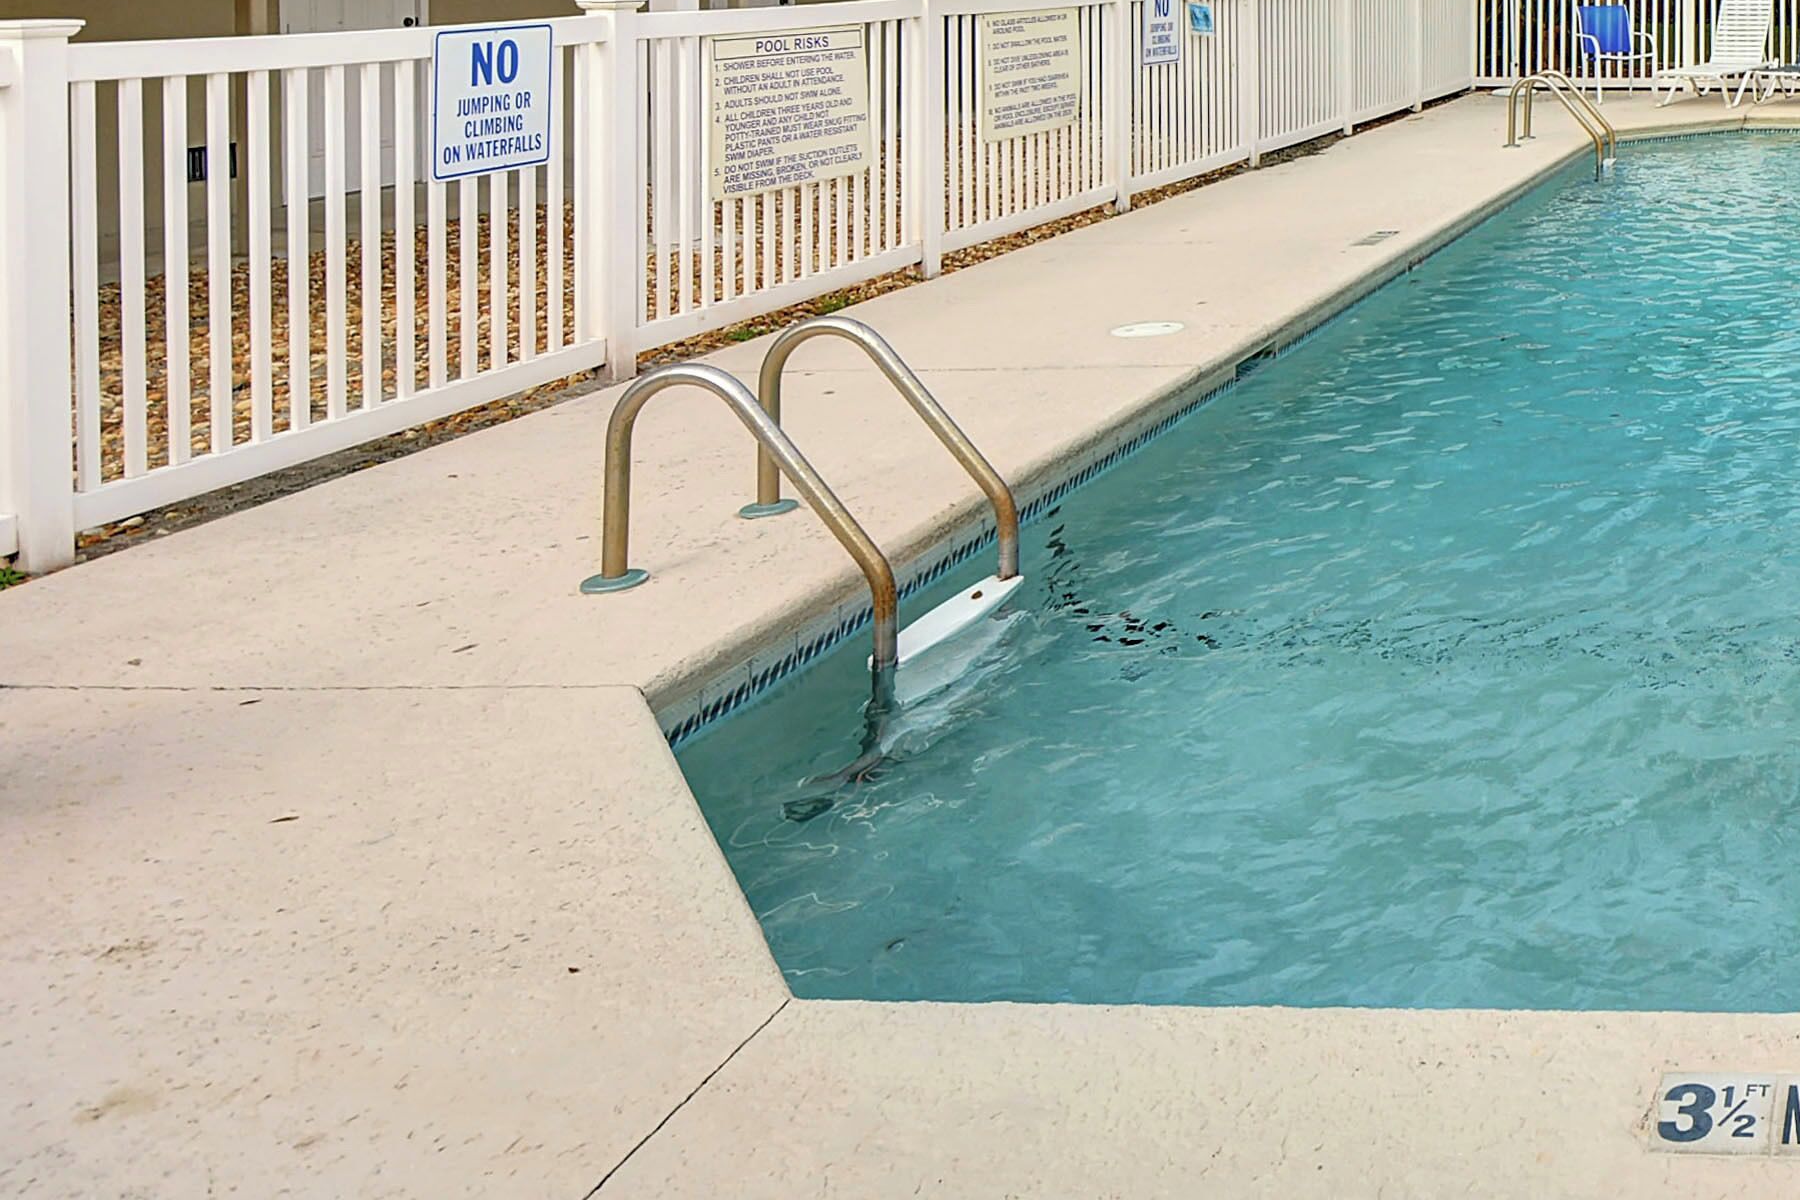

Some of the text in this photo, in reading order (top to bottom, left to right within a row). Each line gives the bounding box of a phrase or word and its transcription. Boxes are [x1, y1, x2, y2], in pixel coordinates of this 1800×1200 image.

[756, 36, 829, 53] POOL RISKS
[472, 39, 518, 86] NO
[723, 60, 755, 71] SHOWER
[757, 57, 784, 68] BEFORE
[786, 54, 820, 65] ENTERING
[821, 53, 833, 61] THE
[723, 74, 760, 86] CHILDREN
[761, 72, 784, 82] SHALL
[785, 70, 800, 79] NOT
[801, 68, 814, 77] USE
[815, 66, 834, 75] POOL
[723, 83, 757, 95] WITHOUT
[758, 81, 768, 90] AN
[769, 79, 791, 89] ADULT
[792, 78, 800, 87] IN
[457, 91, 531, 117] JUMPING OR
[724, 97, 753, 108] ADULTS
[754, 94, 783, 105] SHOULD
[784, 92, 799, 101] NOT
[800, 90, 818, 99] SWIM
[724, 113, 739, 122] ALL
[740, 109, 776, 120] CHILDREN
[778, 105, 801, 115] THREE
[802, 102, 824, 112] YEARS
[825, 99, 839, 108] OLD
[839, 98, 853, 106] AND
[465, 114, 522, 138] CLIMBING
[725, 109, 829, 132] YOUNGER AND ANY CHILD NOT
[725, 112, 867, 142] POTTY-TRAINED MUST WEAR SNUG FITTING
[443, 133, 541, 164] ON WATERFALLS
[725, 140, 756, 152] PLASTIC
[757, 136, 780, 147] PANTS
[781, 133, 792, 143] OR
[799, 129, 822, 139] WATER
[823, 123, 857, 136] RESISTANT
[724, 164, 737, 175] DO
[738, 162, 753, 172] NOT
[755, 158, 774, 169] SWIM
[775, 157, 783, 165] IF
[784, 154, 797, 163] THE
[798, 149, 828, 161] SUCTION
[829, 143, 858, 156] OUTLETS
[725, 151, 745, 162] SWIM
[723, 174, 741, 185] ARE
[808, 160, 819, 169] OR
[820, 157, 834, 167] NOT
[834, 152, 863, 164] CLEARLY
[723, 182, 754, 194] VISIBLE
[755, 177, 777, 188] FROM
[778, 174, 793, 184] THE
[1744, 1084, 1770, 1099] FT
